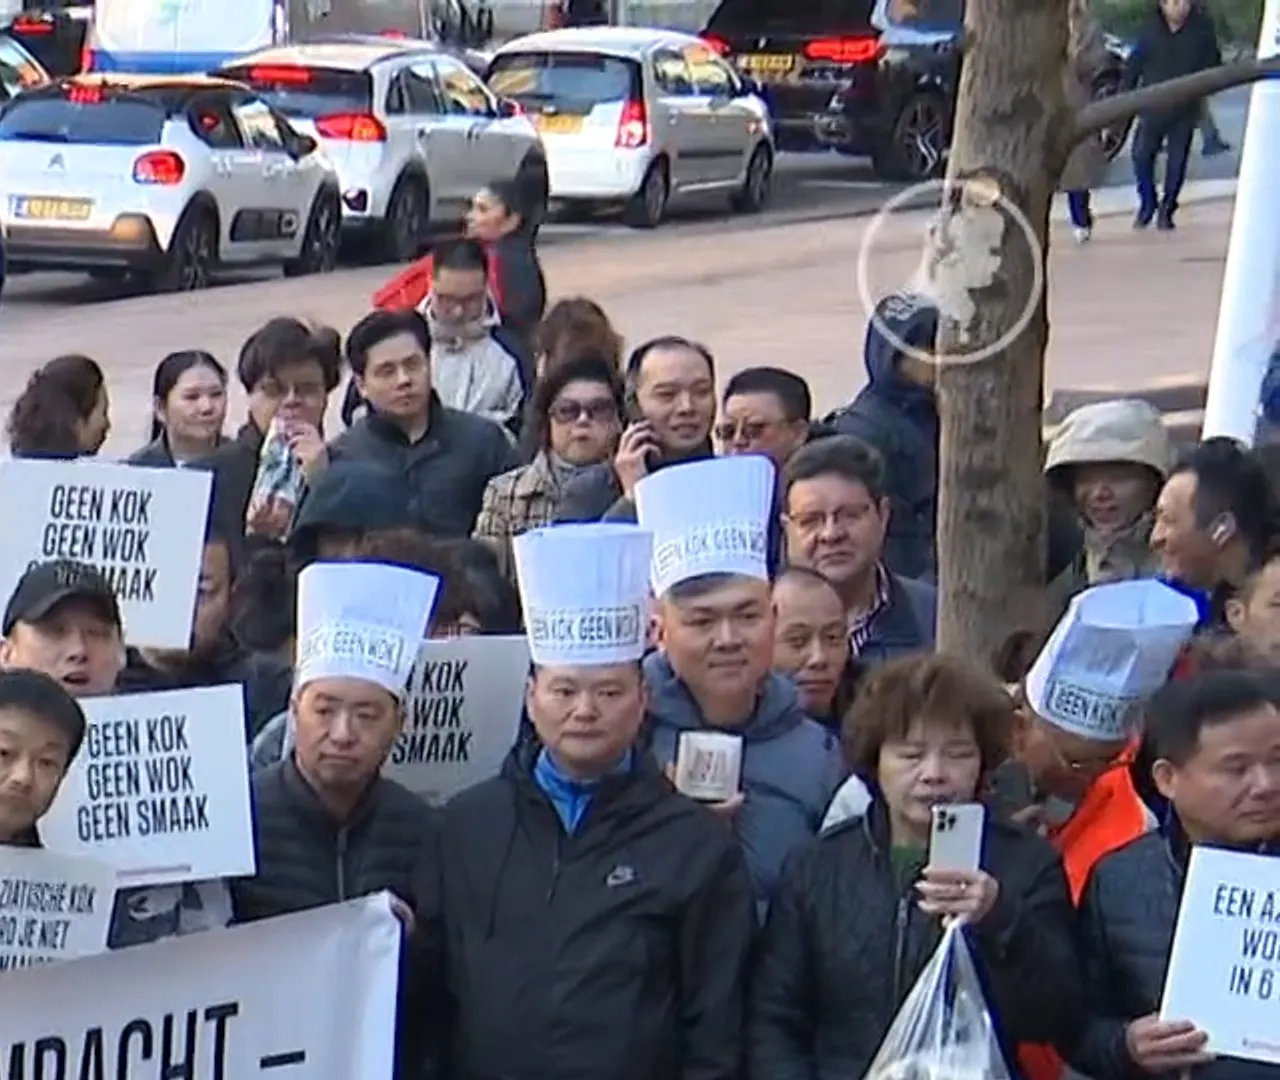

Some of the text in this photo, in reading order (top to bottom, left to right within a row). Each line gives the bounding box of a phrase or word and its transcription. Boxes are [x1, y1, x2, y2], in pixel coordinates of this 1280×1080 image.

[50, 484, 153, 525] GEEN KOK
[42, 522, 149, 563] GEEN WOK
[421, 660, 468, 693] KOK
[412, 696, 466, 730] WOK
[87, 714, 189, 759] GEEN KOK
[392, 732, 473, 765] SMAAK
[87, 756, 194, 801] GEEN WOK
[77, 794, 210, 842] GEEN SMAAK
[1213, 882, 1255, 919] EEN
[1229, 963, 1275, 1000] IN 6
